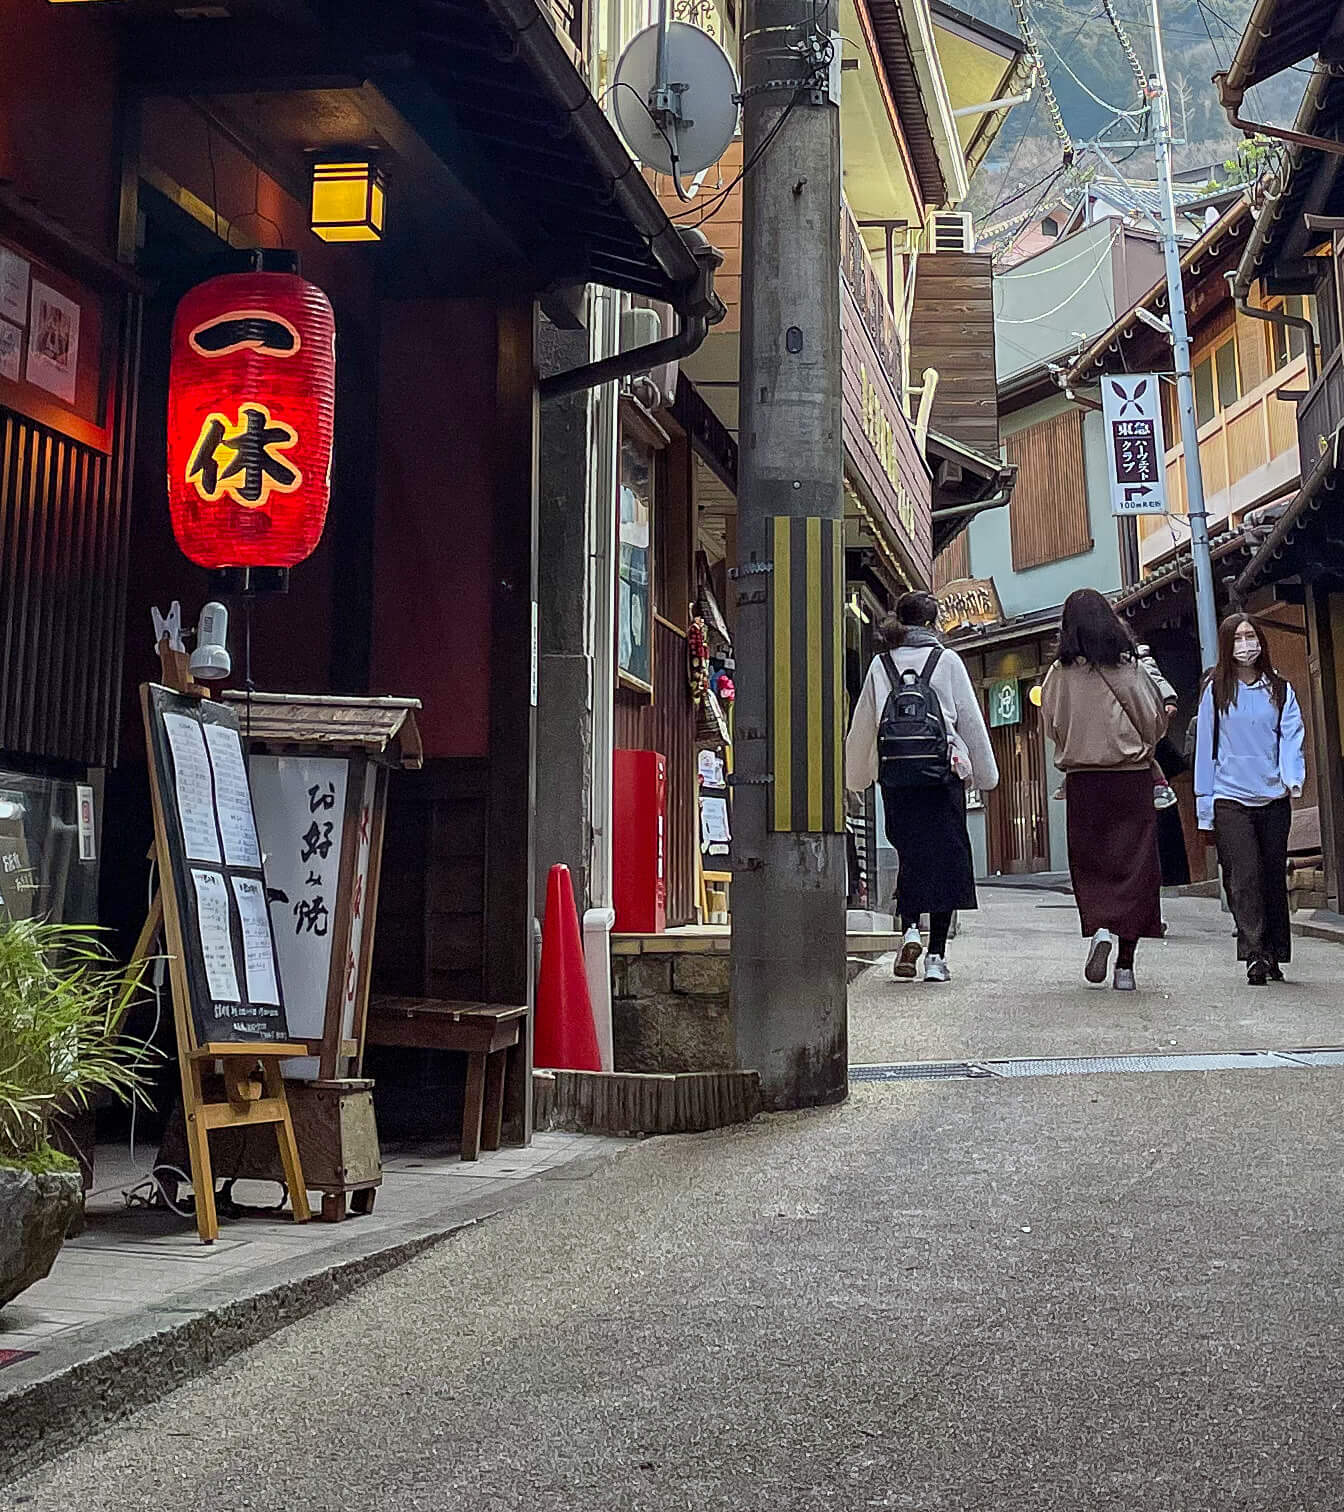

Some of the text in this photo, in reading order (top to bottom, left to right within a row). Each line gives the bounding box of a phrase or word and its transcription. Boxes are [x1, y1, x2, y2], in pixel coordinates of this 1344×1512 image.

[187, 312, 301, 506] 一休
[1118, 422, 1151, 436] 東急
[1122, 440, 1136, 473] クラブ
[293, 781, 335, 936] お好み焼
